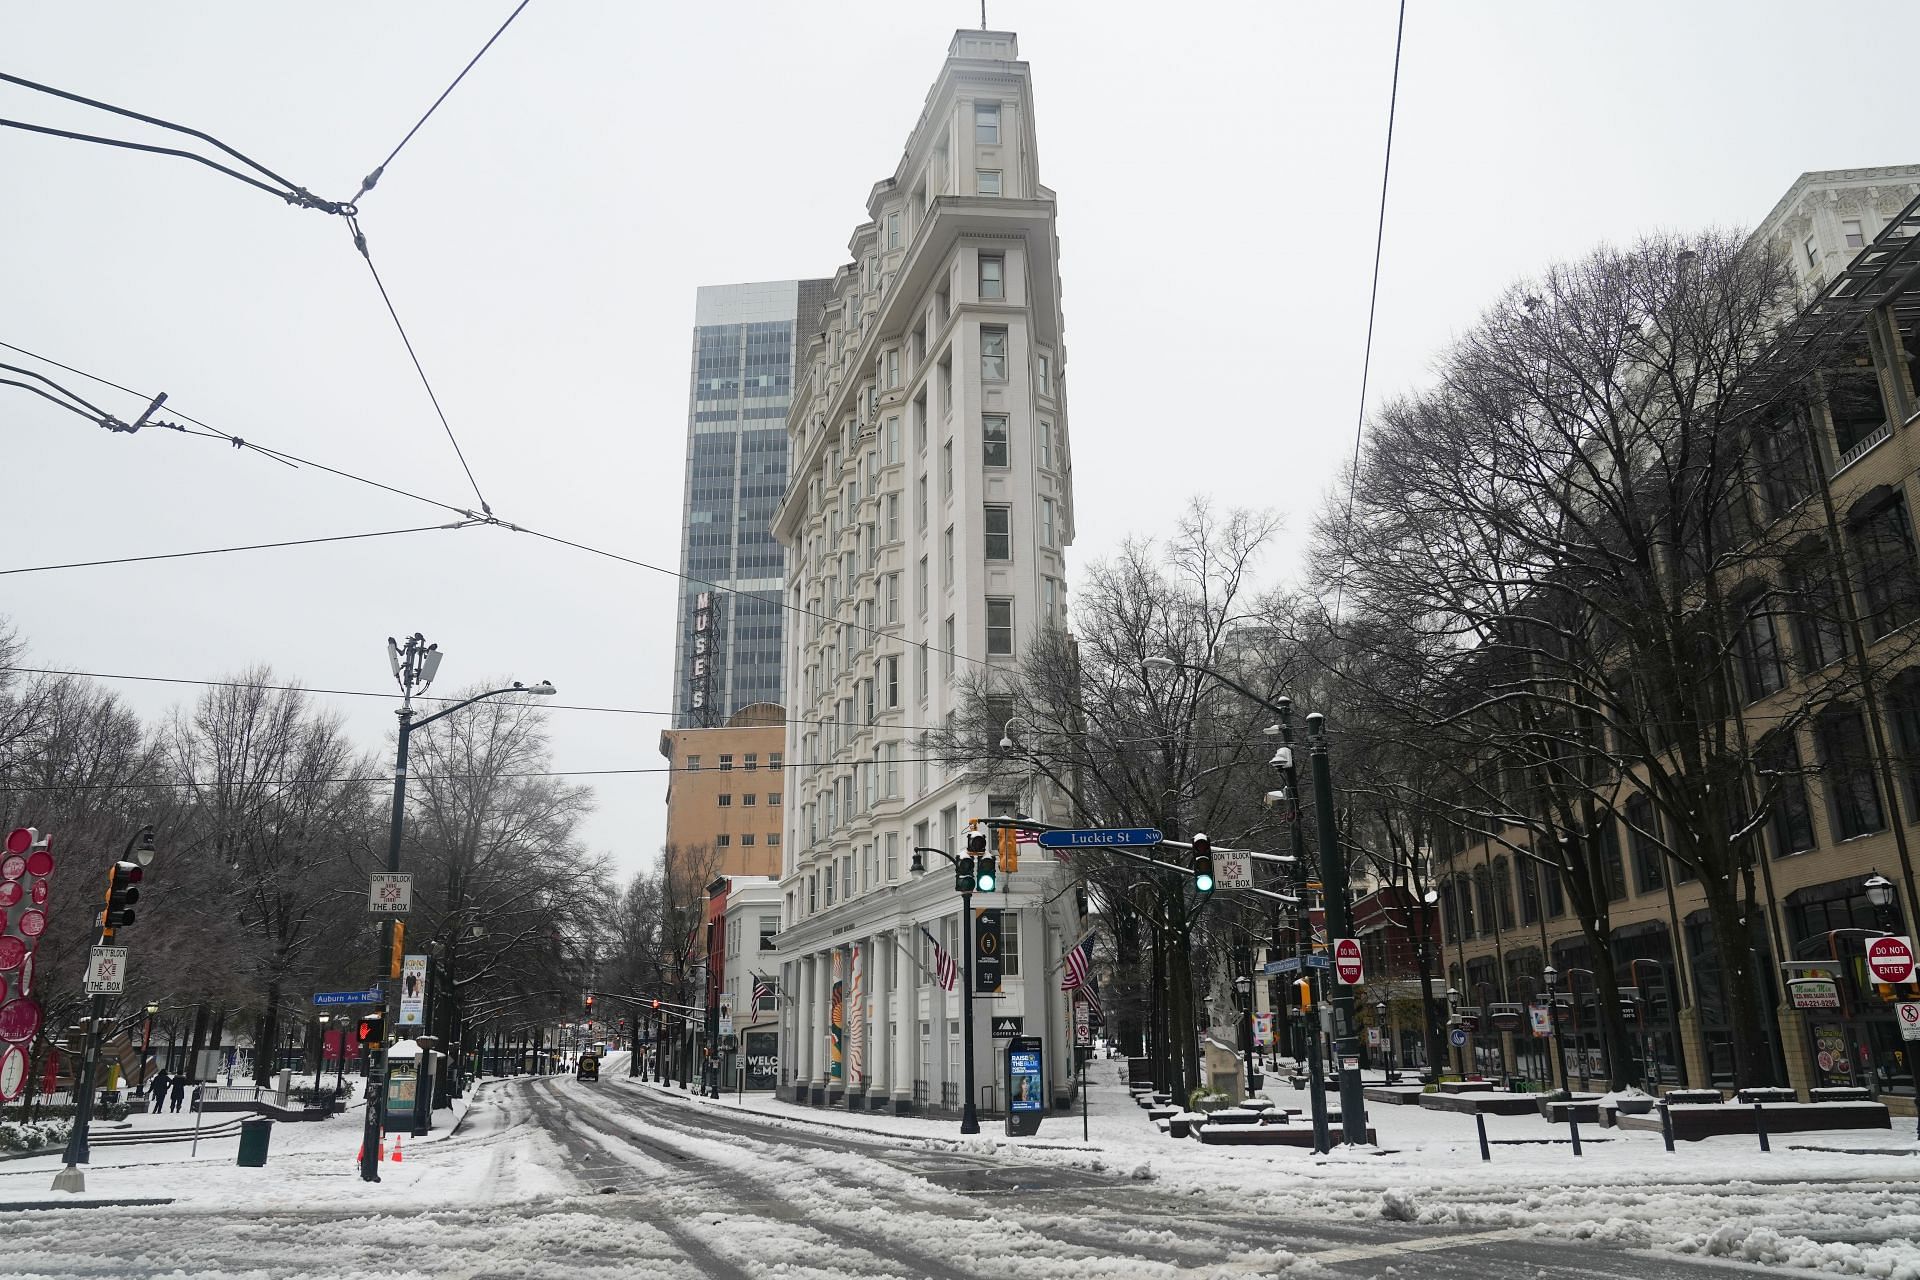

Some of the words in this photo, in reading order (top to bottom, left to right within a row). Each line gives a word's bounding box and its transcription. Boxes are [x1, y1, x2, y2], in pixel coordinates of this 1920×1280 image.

[1071, 832, 1113, 843] Luckie
[1117, 832, 1130, 842] St
[1145, 832, 1160, 840] NW
[1232, 852, 1249, 860] BLOCK
[1217, 880, 1232, 888] THE
[1235, 879, 1250, 887] BOX
[372, 903, 387, 911] THE
[391, 903, 408, 911] BOX
[92, 948, 109, 957] DON'T
[110, 949, 127, 957] BLOCK
[1875, 947, 1887, 955] DO
[1889, 946, 1905, 954] NOT
[1879, 966, 1905, 974] ENTER
[90, 981, 104, 990] THE
[106, 981, 121, 990] BOX
[317, 995, 345, 1003] Auburn
